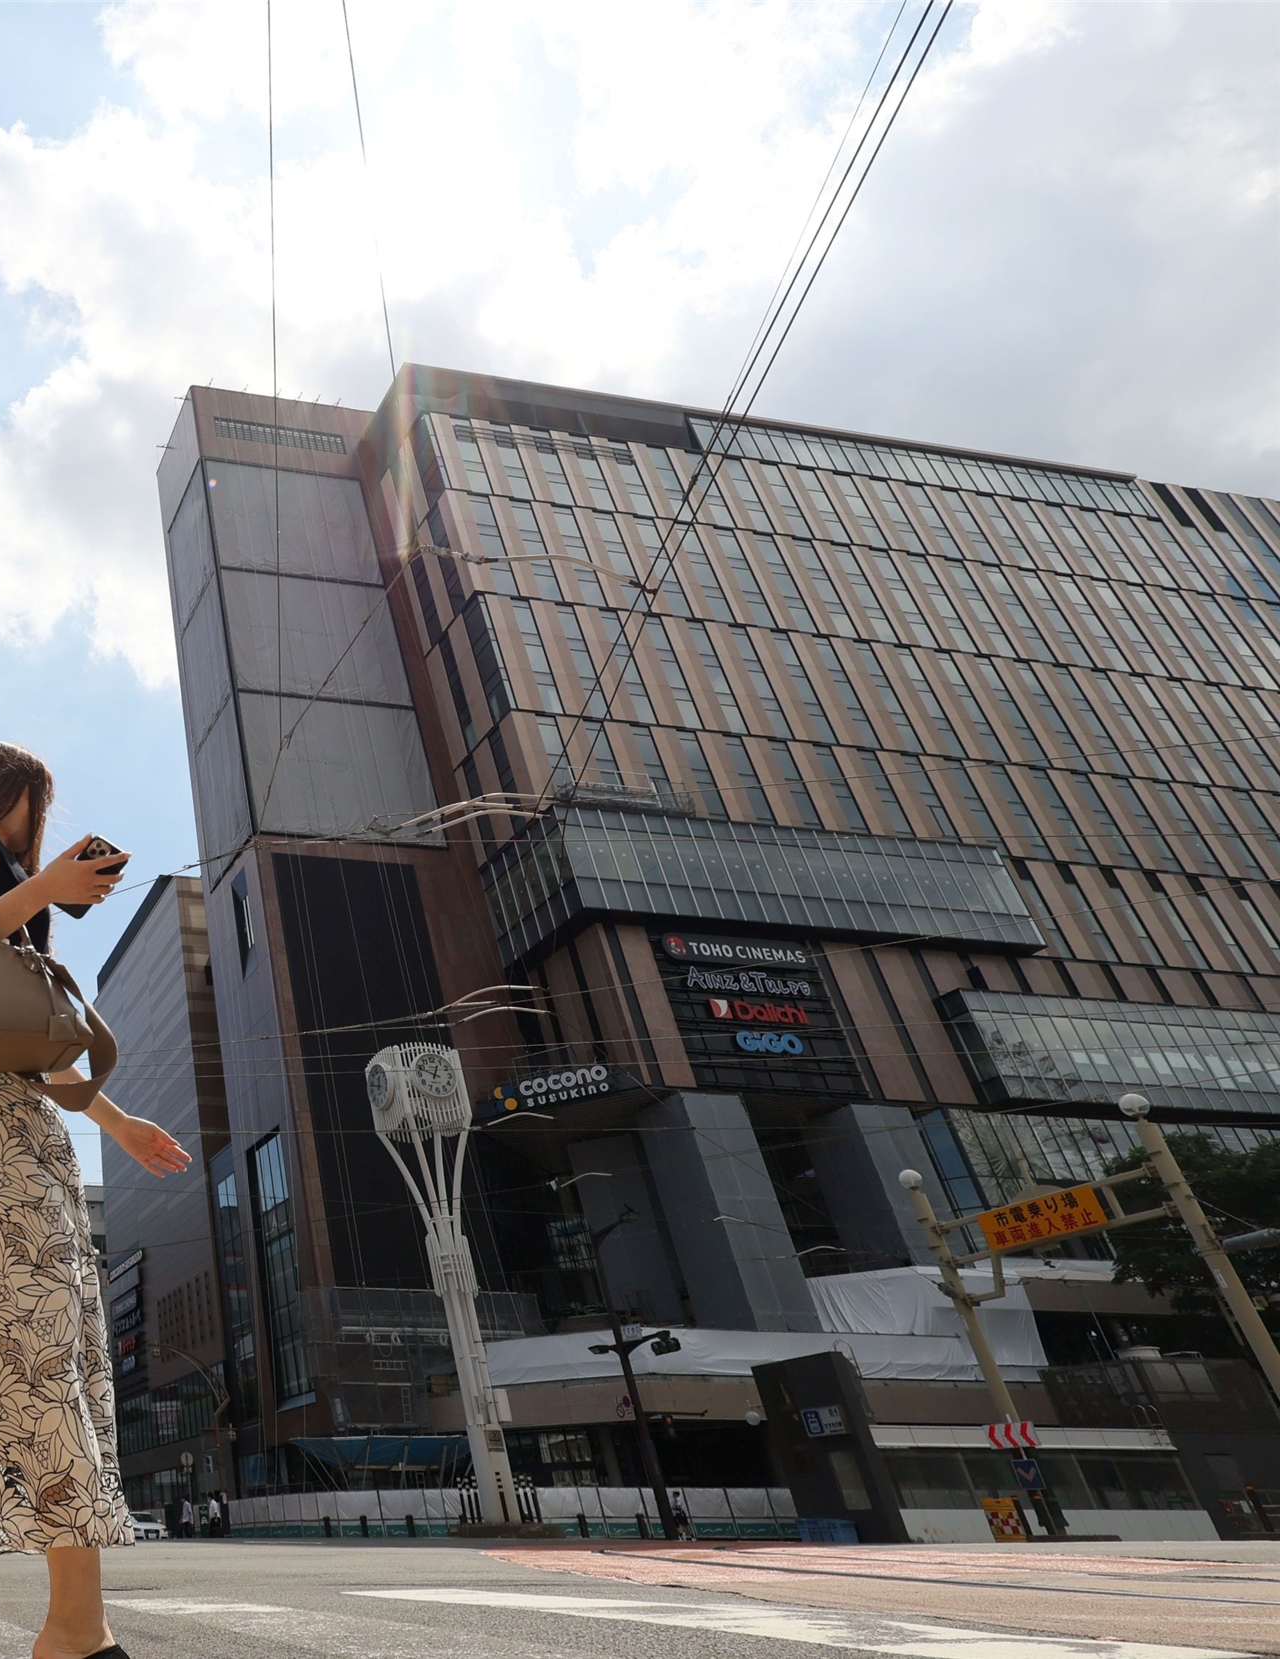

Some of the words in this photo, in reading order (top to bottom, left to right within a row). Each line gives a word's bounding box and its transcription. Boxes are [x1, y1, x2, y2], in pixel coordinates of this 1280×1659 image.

[688, 942, 734, 958] TOHO
[735, 945, 807, 964] CINEMAS
[733, 1001, 810, 1025] Daiichi
[993, 1192, 1080, 1228] 市電乗り場
[993, 1208, 1099, 1247] 車両進入禁止
